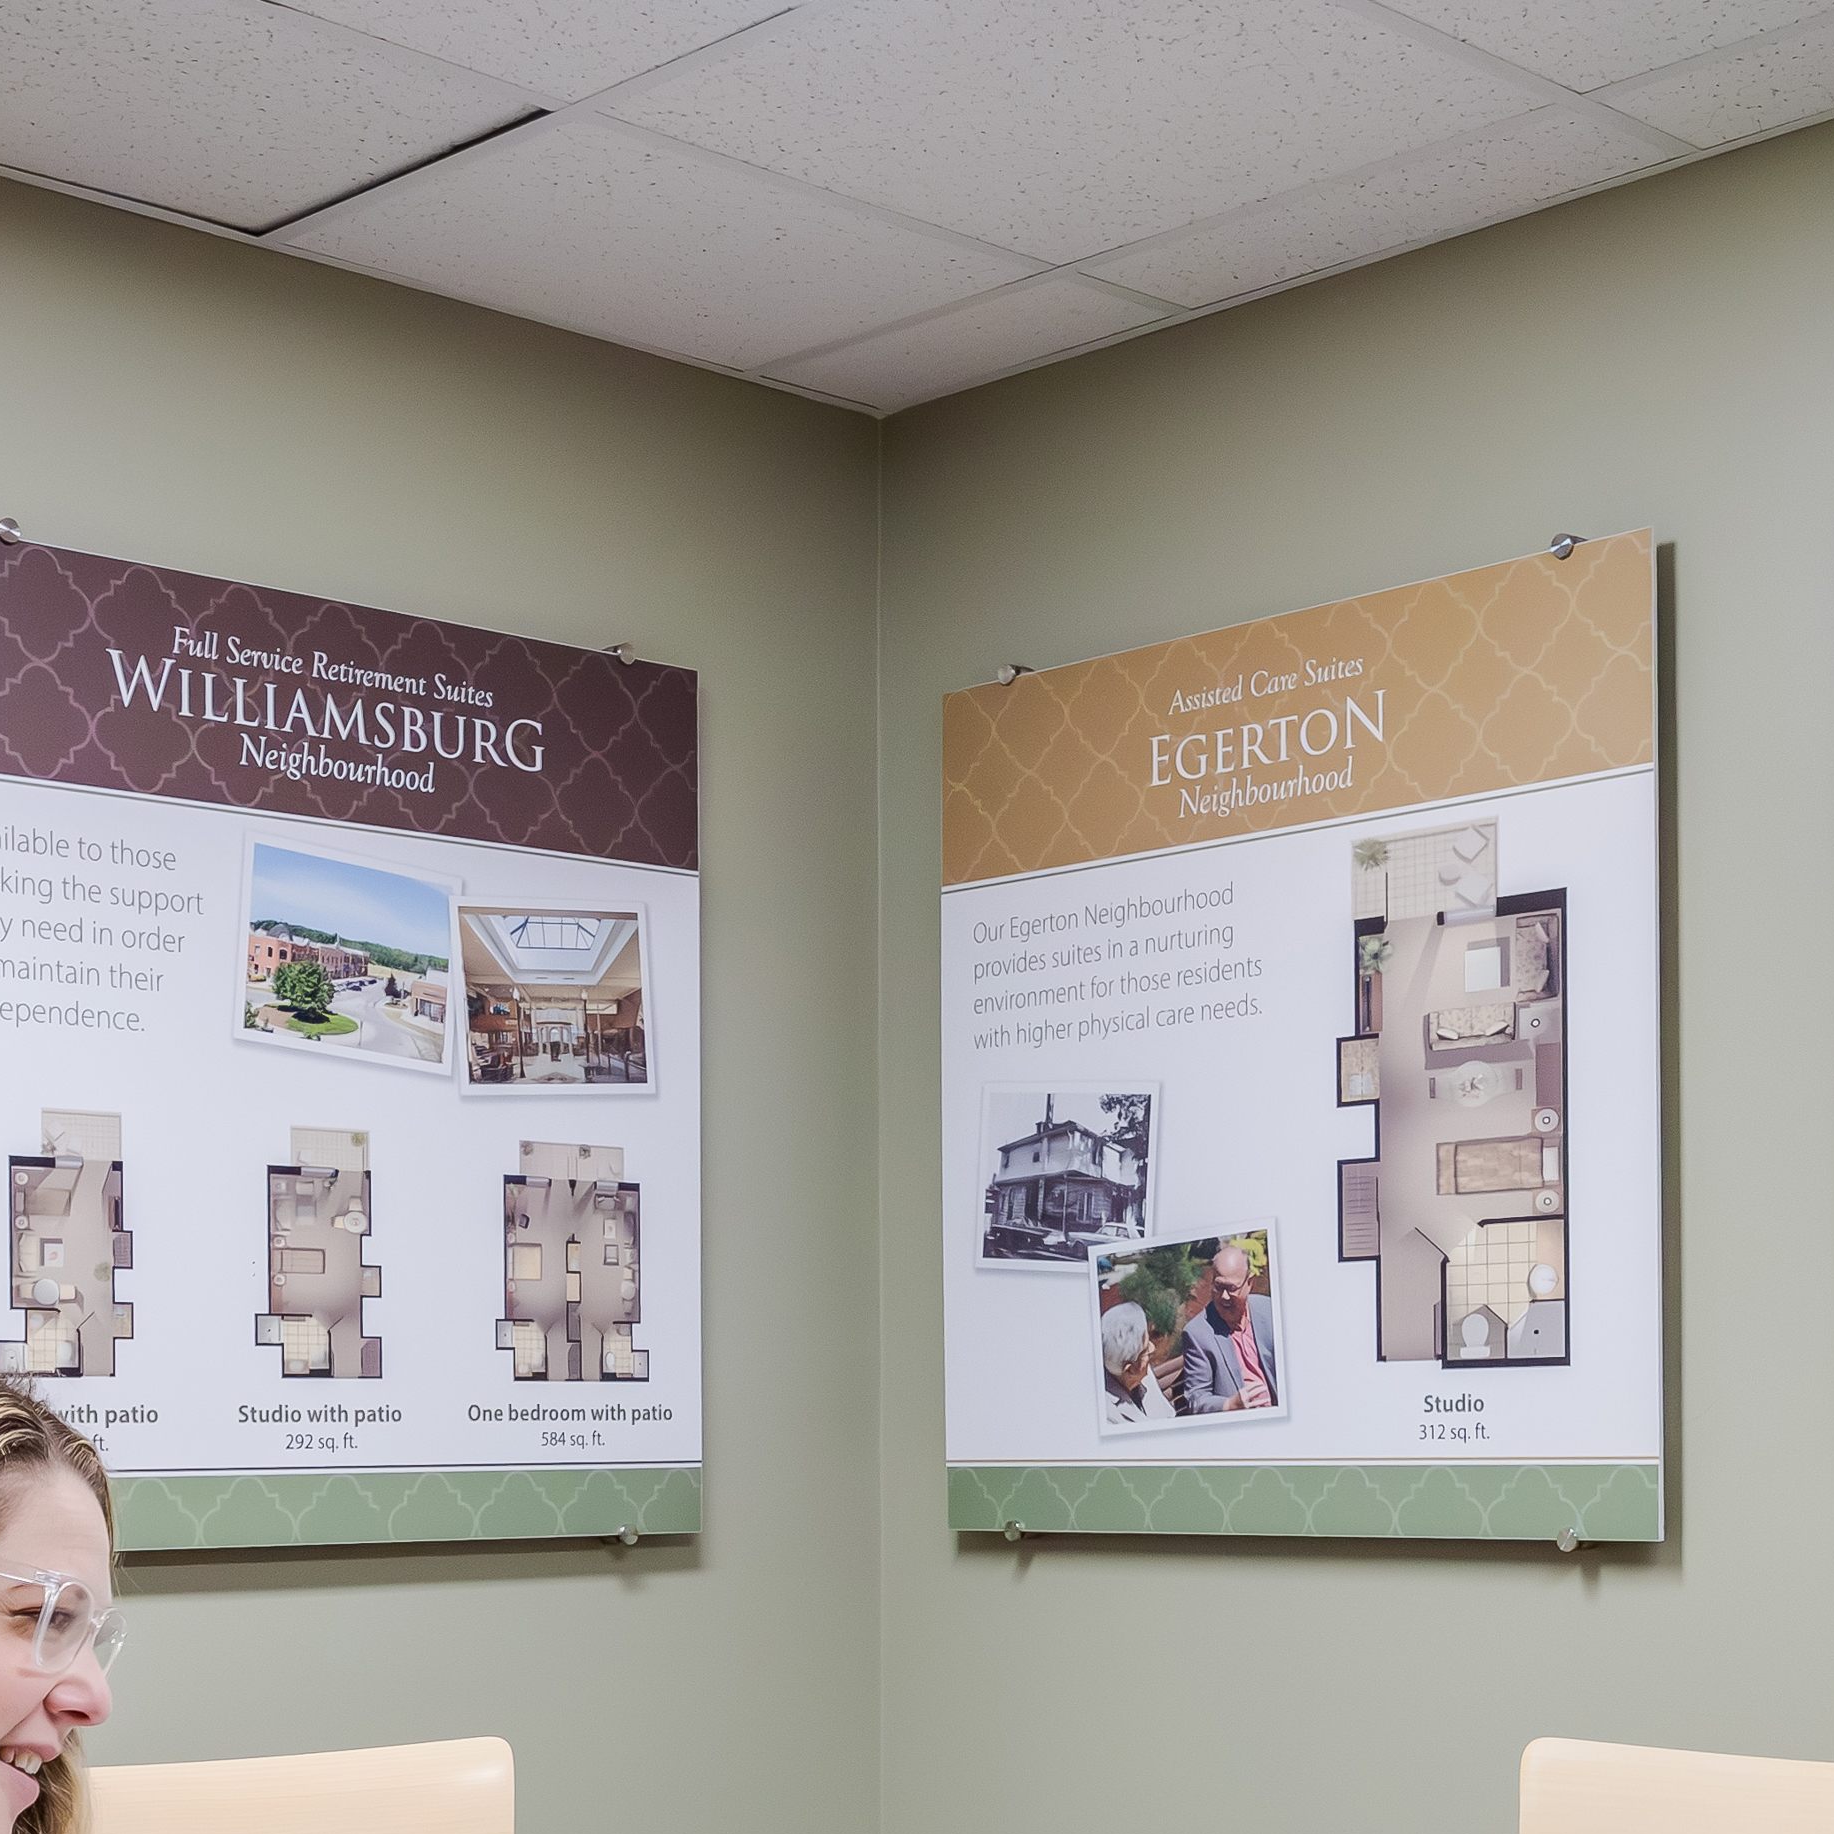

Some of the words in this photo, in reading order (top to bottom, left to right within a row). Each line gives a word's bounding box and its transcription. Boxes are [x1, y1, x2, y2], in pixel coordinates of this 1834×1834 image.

[173, 626, 219, 660] Full
[226, 636, 302, 674] Service
[312, 651, 426, 695] Retirement
[434, 673, 493, 707] Suites
[1168, 675, 1242, 715] Assisted
[1251, 671, 1297, 697] Care
[1304, 657, 1363, 686] Suites
[106, 648, 545, 771] WILLIAMSBURG
[1149, 690, 1386, 790] EGERTON
[240, 733, 435, 793] Neighbourhood
[1179, 756, 1352, 818] Neighbourhood
[78, 837, 102, 861] to
[110, 839, 176, 871] those
[62, 875, 101, 903] the
[110, 887, 204, 916] support
[973, 922, 1005, 944] Our
[1010, 913, 1078, 942] Egerton
[1085, 881, 1233, 928] Neighbourhood
[22, 917, 83, 943] need
[93, 921, 112, 946] in
[122, 926, 185, 953] order
[974, 950, 1046, 985] provides
[1052, 944, 1101, 968] suites
[1108, 939, 1122, 959] in
[1129, 940, 1138, 956] a
[1146, 924, 1233, 954] nurturing
[109, 963, 164, 991] their
[974, 981, 1085, 1014] environment
[1091, 975, 1114, 998] for
[1120, 971, 1170, 995] those
[1177, 957, 1262, 987] residents
[974, 1024, 1010, 1049] with
[1017, 1019, 1073, 1048] higher
[1079, 1005, 1149, 1042] physical
[1156, 1007, 1194, 1027] care
[1201, 993, 1262, 1021] needs.
[104, 1404, 159, 1428] patio
[239, 1404, 301, 1423] Studio
[307, 1404, 348, 1422] with
[355, 1405, 401, 1427] patio
[468, 1405, 503, 1421] One
[509, 1404, 585, 1421] bedroom
[591, 1404, 626, 1421] with
[632, 1404, 672, 1425] patio
[1424, 1393, 1484, 1413] Studio
[286, 1434, 313, 1449] 292
[318, 1437, 339, 1453] sq.
[343, 1432, 358, 1449] ft.
[541, 1432, 566, 1446] 584
[570, 1435, 588, 1449] sq.
[592, 1430, 605, 1446] ft.
[1419, 1424, 1445, 1440] 312
[1451, 1428, 1470, 1444] sq.
[1475, 1422, 1490, 1439] ft.
